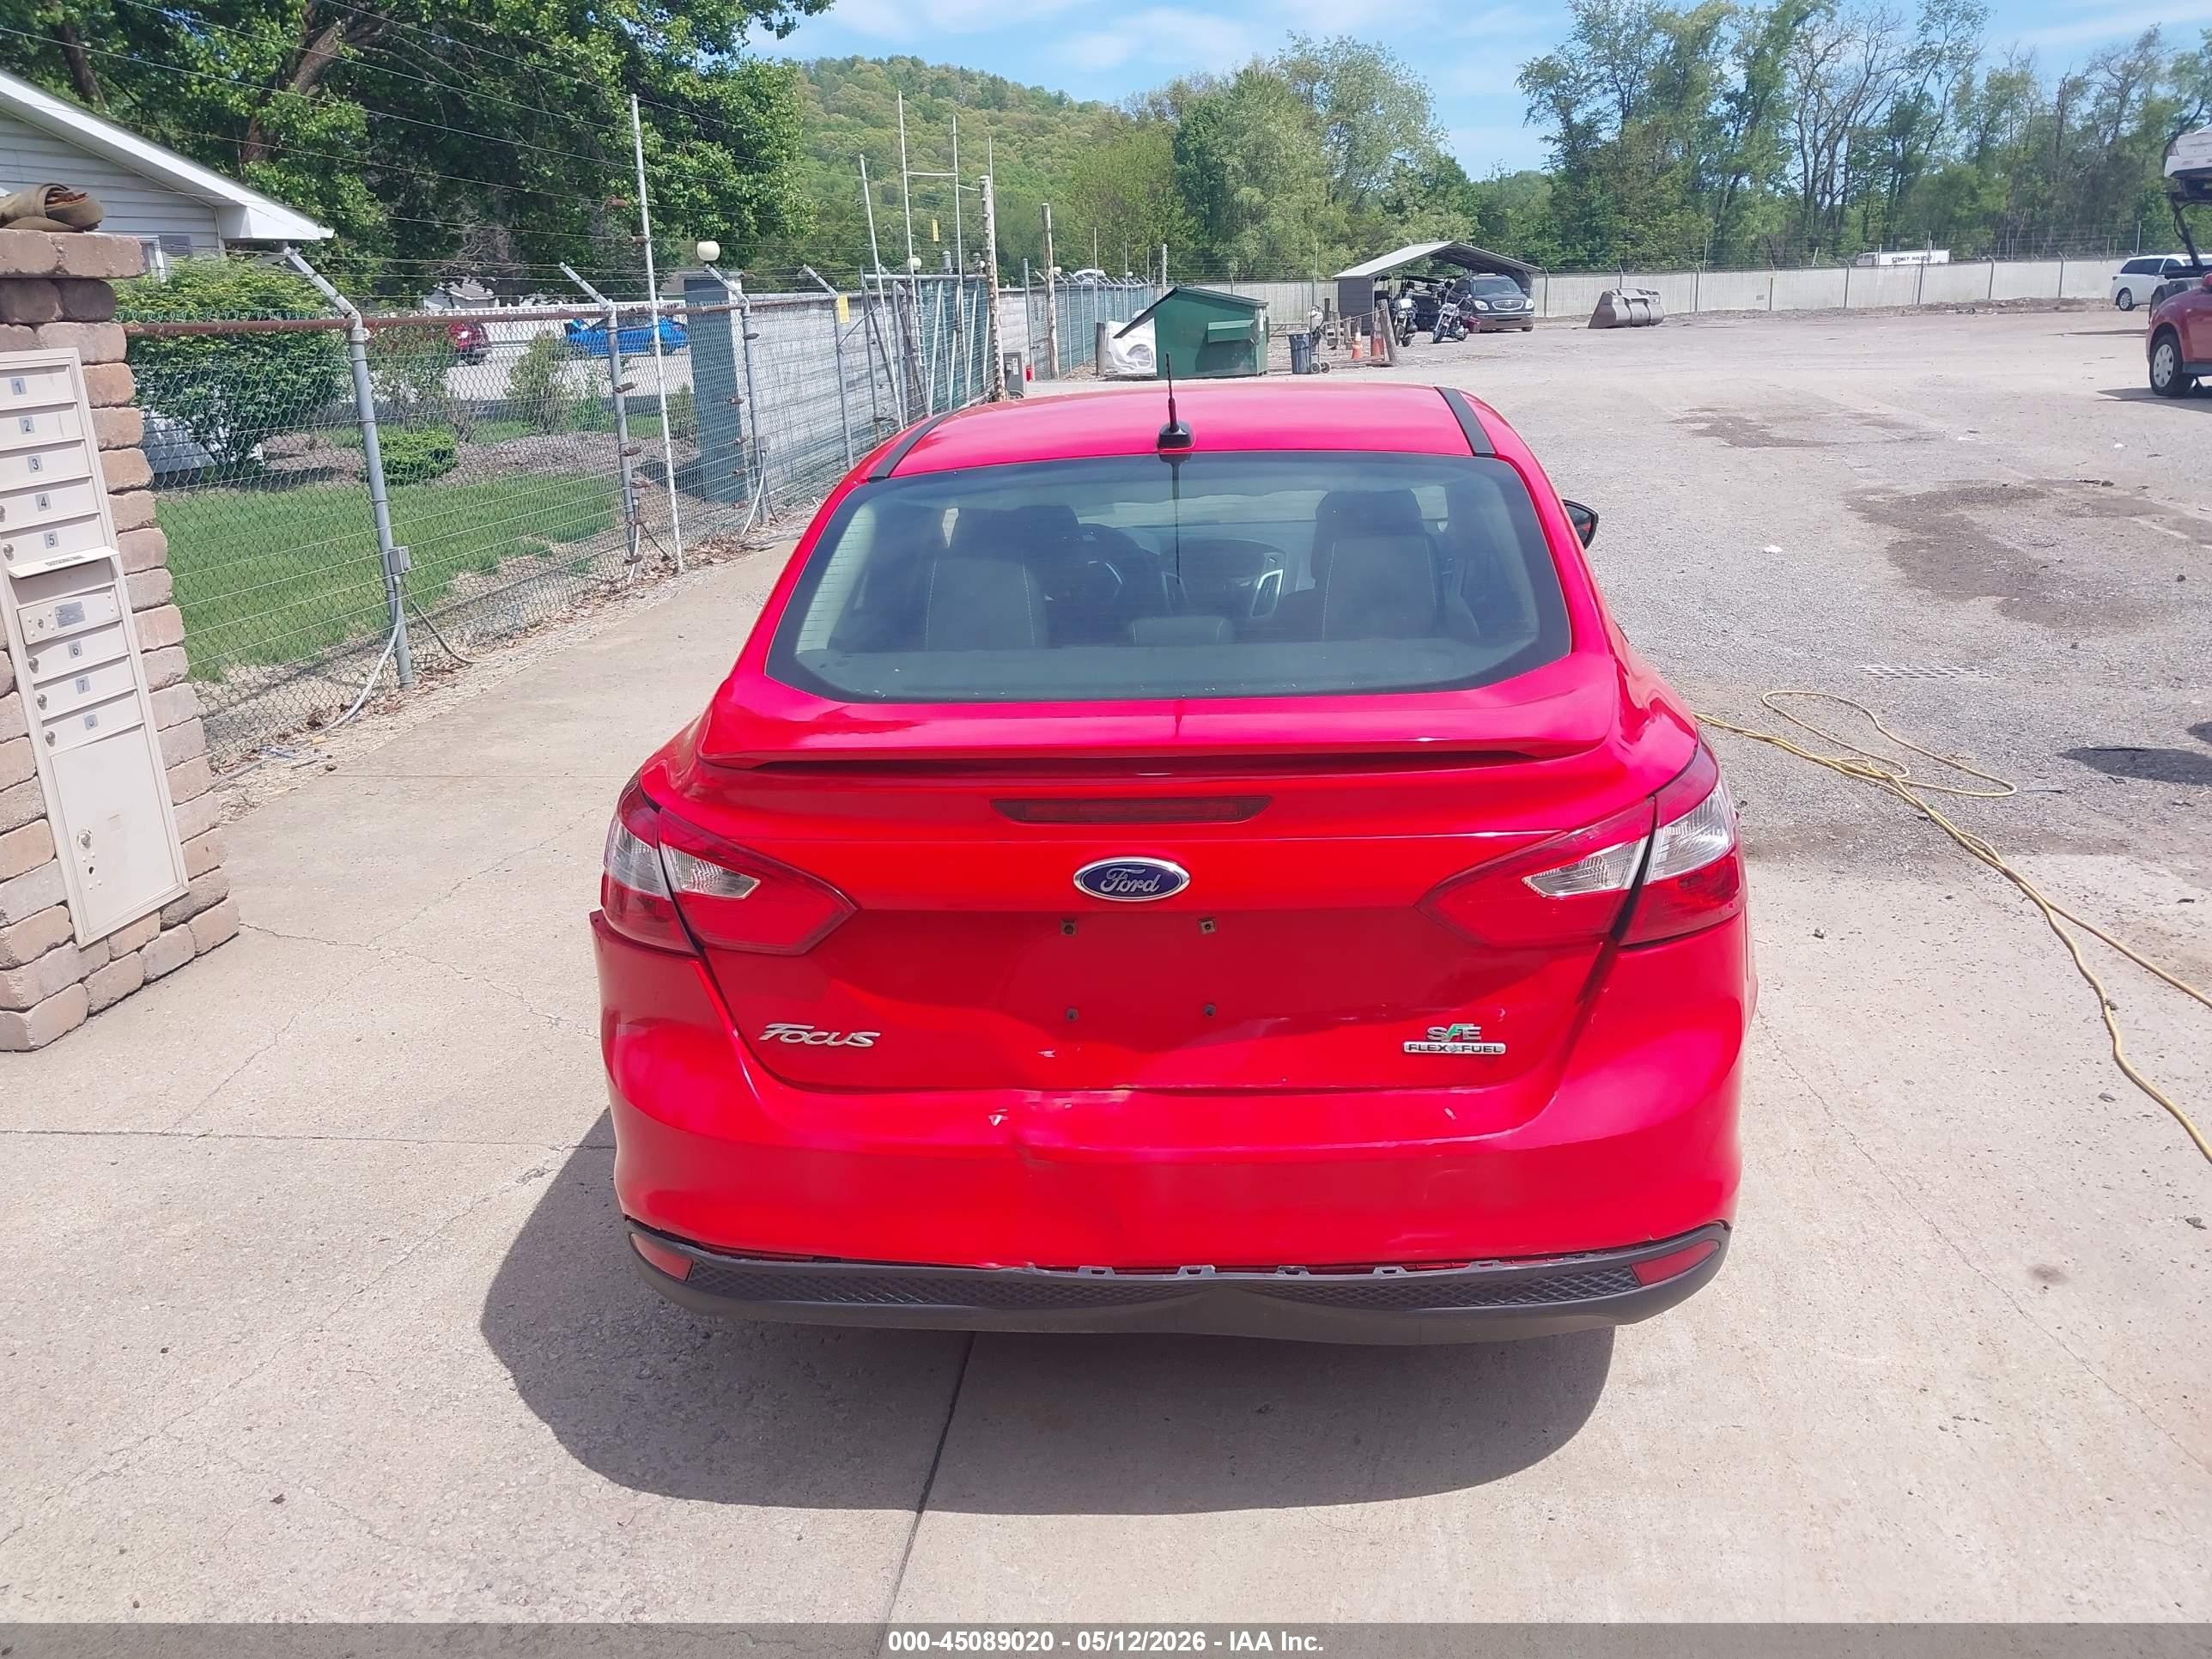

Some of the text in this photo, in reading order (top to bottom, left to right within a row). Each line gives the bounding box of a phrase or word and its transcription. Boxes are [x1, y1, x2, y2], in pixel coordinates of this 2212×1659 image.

[1100, 867, 1161, 892] Ford
[758, 1023, 881, 1048] FOCUS
[1407, 1043, 1504, 1054] FLEX FUEL
